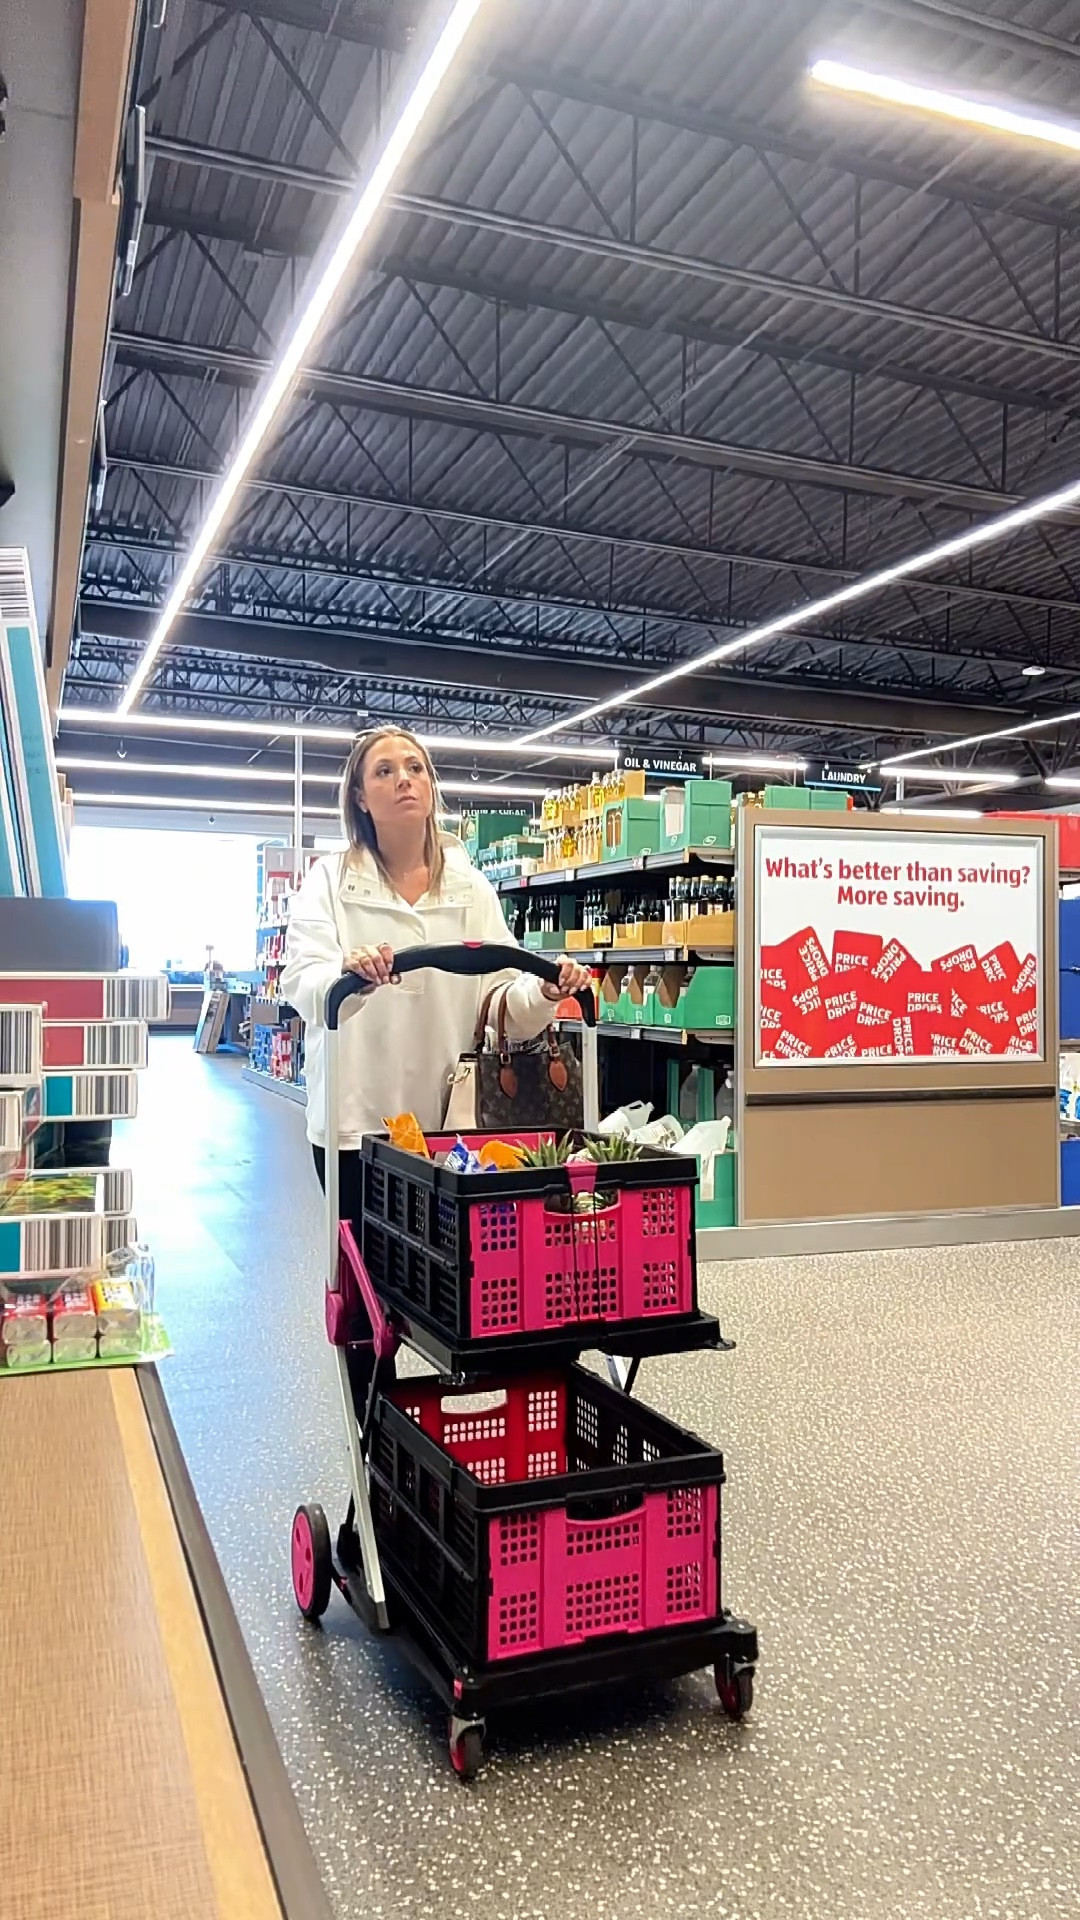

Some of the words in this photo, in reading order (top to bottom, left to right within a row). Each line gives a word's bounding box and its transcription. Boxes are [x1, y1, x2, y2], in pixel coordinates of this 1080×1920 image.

[624, 757, 640, 768] OIL
[643, 759, 650, 769] &
[653, 760, 697, 772] VINEGAR
[821, 770, 866, 784] LAUNDRY
[765, 857, 833, 879] What's
[839, 858, 902, 881] better
[906, 861, 952, 882] than
[958, 862, 1031, 888] saving?
[837, 885, 888, 905] More
[893, 885, 965, 912] saving.
[799, 945, 821, 982] PRICE
[806, 937, 829, 978] DROPS
[835, 953, 869, 966] PRICE
[871, 943, 900, 979] DROPS
[880, 951, 907, 983] PRICE
[792, 985, 819, 1007] ROPS
[824, 990, 858, 1009] PRICE
[907, 992, 939, 1003] PRICE
[859, 1001, 892, 1021] PRICE
[976, 1001, 1005, 1016] RICE
[779, 1029, 812, 1057] PRICE
[902, 1016, 914, 1054] PRICE
[963, 1027, 994, 1055] PRICE
[861, 1044, 893, 1057] PRICE
